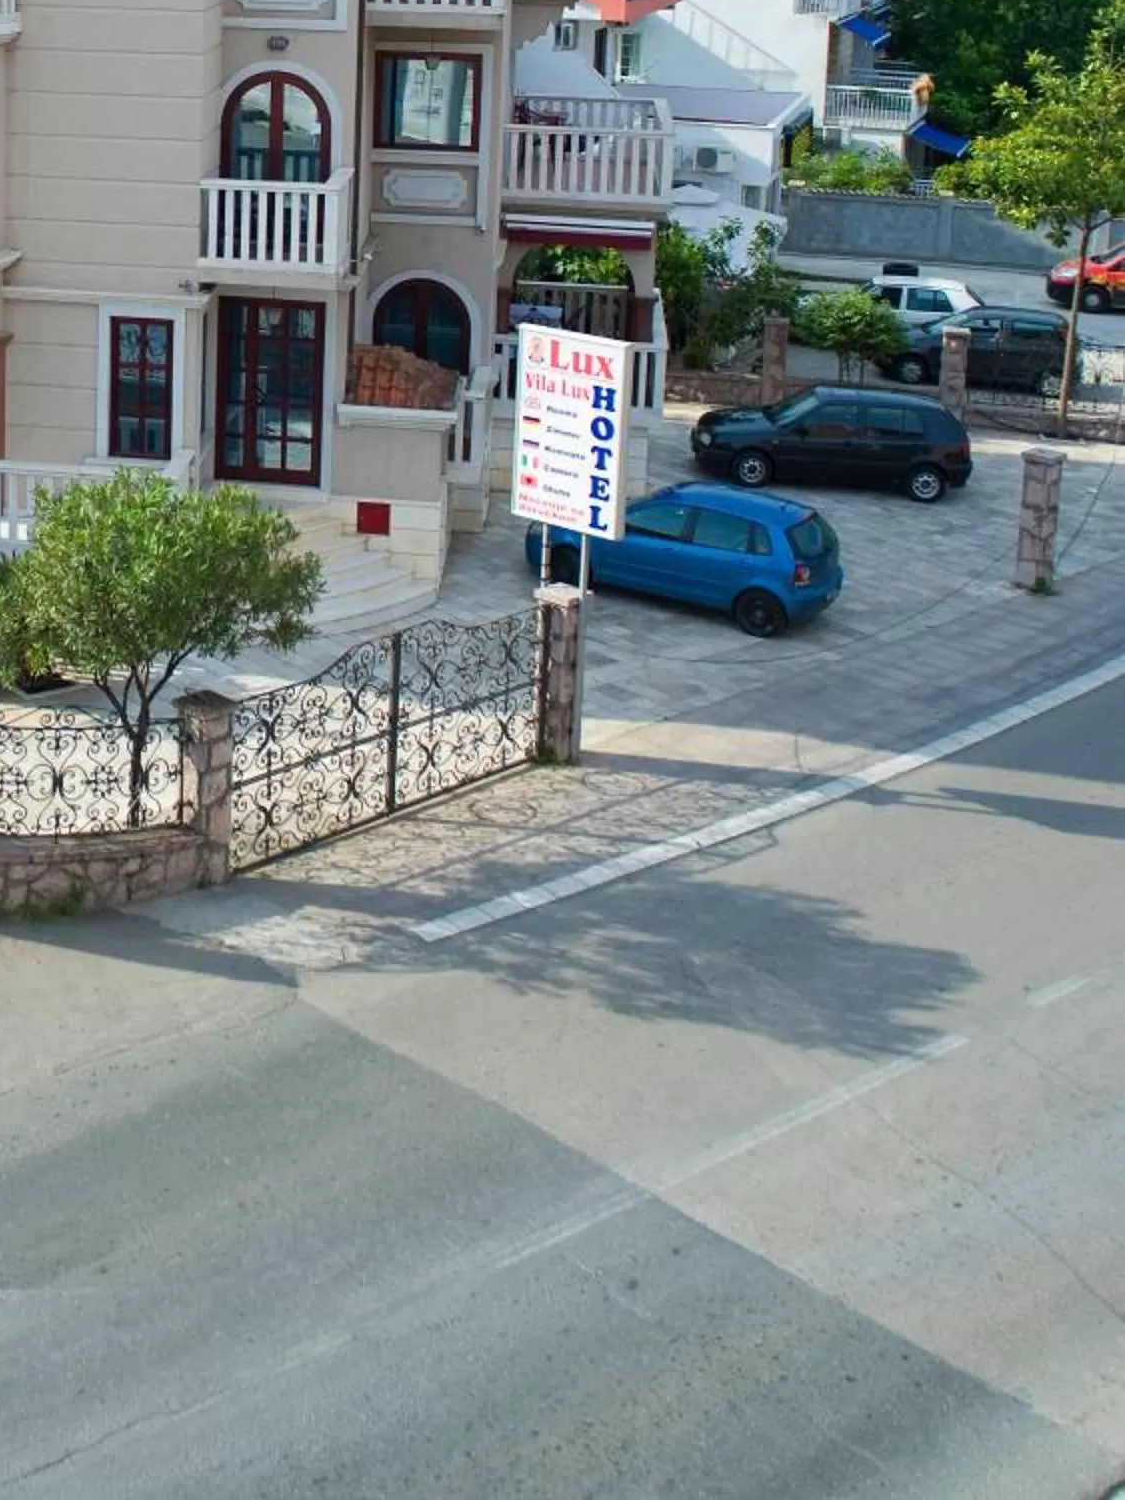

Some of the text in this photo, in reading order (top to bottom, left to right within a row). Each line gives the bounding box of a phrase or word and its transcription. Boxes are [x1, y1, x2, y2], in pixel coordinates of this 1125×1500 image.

[550, 339, 615, 381] Lux
[525, 371, 590, 401] Vila Lux
[588, 385, 617, 532] HOTEL
